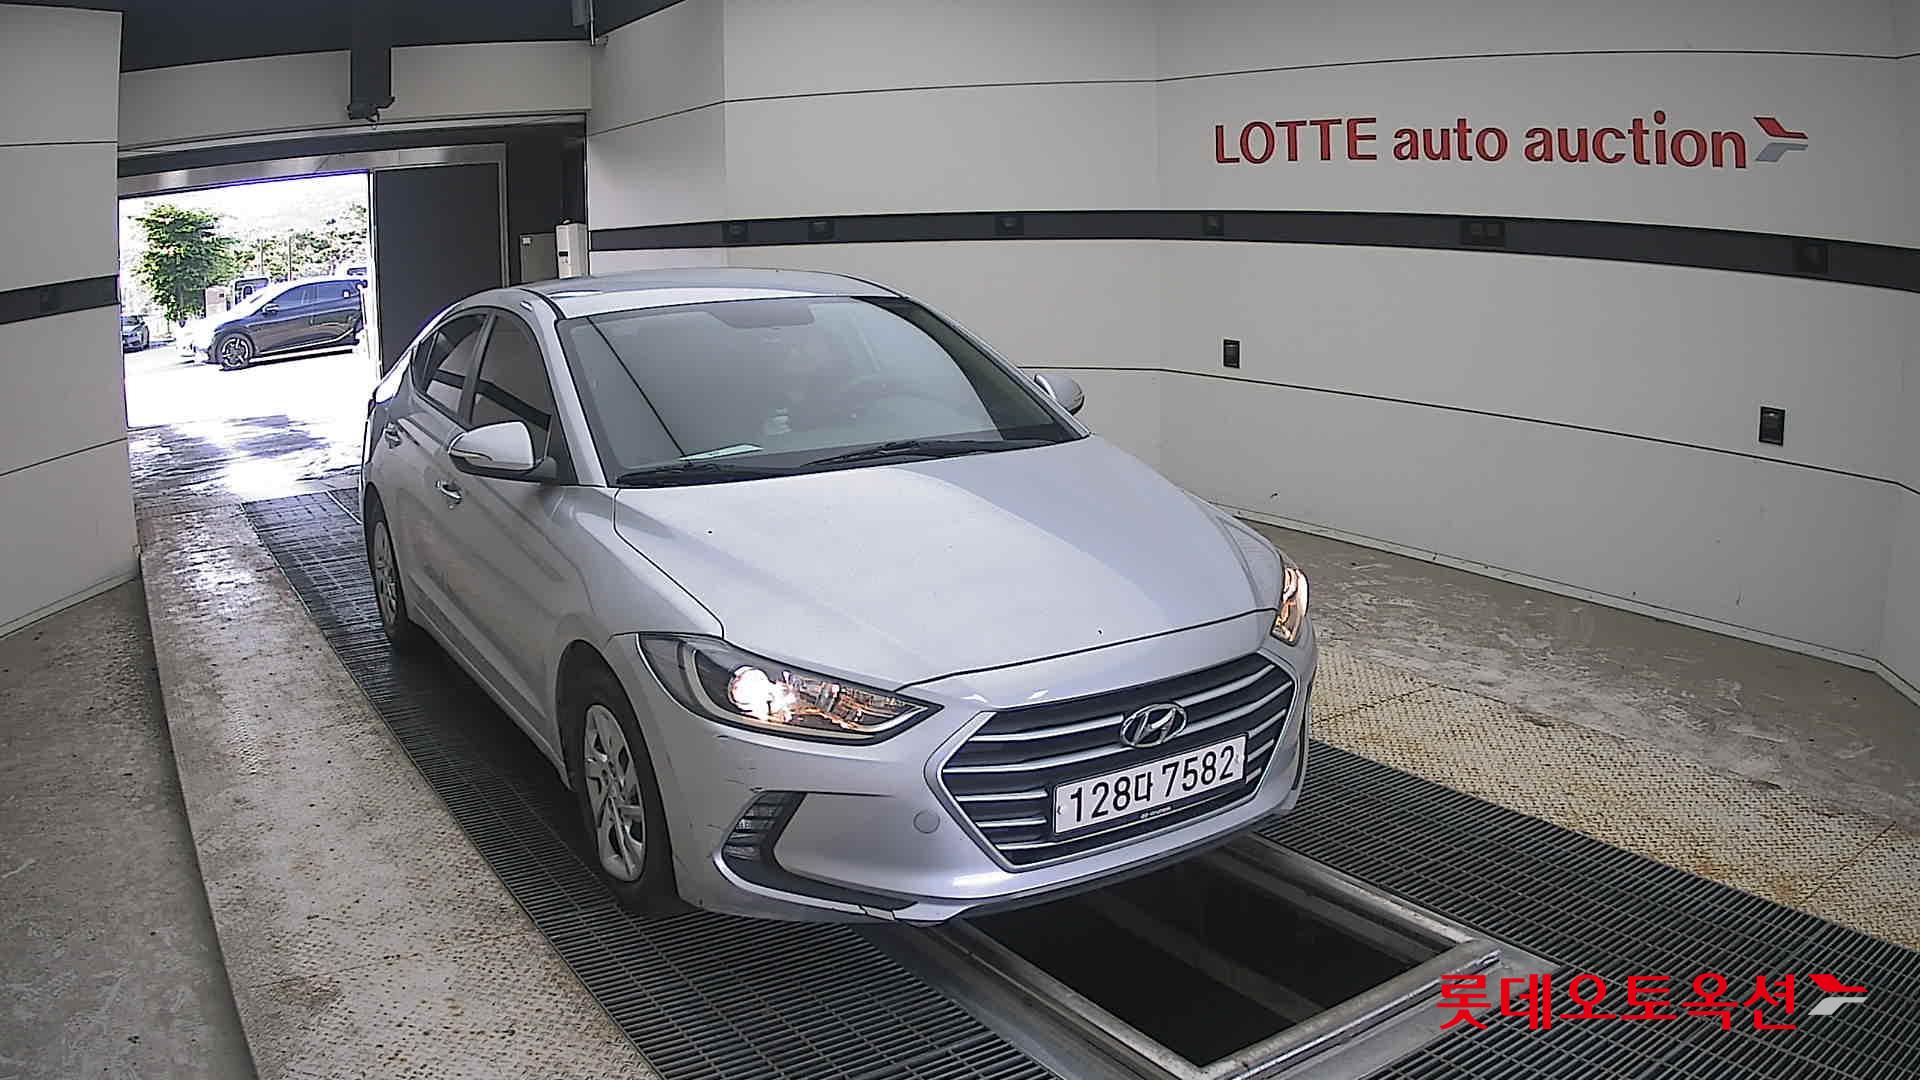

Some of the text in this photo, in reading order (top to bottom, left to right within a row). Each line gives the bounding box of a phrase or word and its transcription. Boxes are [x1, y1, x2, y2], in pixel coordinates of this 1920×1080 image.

[1215, 111, 1747, 168] LOTTE auto auction
[1070, 745, 1235, 823] 128다 7582
